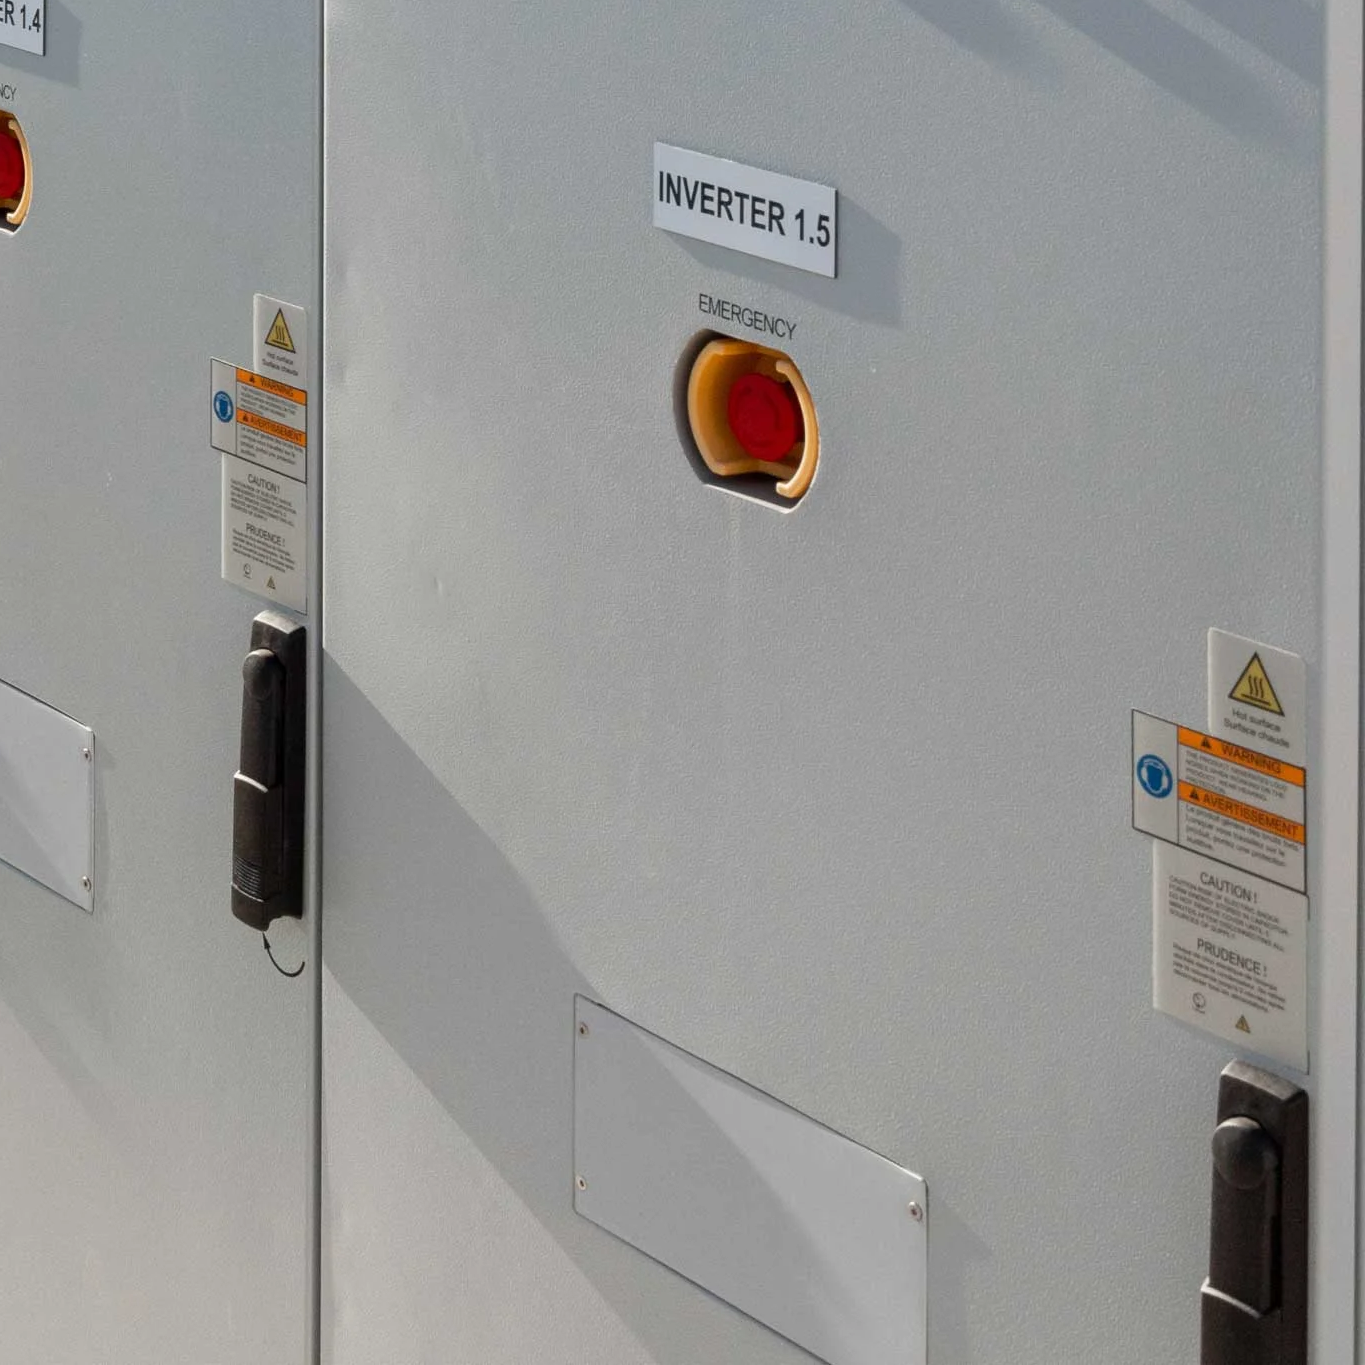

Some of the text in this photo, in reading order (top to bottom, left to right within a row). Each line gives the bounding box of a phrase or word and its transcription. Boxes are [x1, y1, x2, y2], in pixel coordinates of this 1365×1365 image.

[20, 3, 42, 34] 1.4
[659, 170, 831, 248] INVERTER 1.5
[699, 293, 797, 341] EMERGENCY
[245, 522, 282, 546] PRUDENCE
[1223, 717, 1290, 748] Surface chaude
[1232, 707, 1281, 732] Hot surface
[1221, 744, 1282, 774] WARNING
[1204, 793, 1299, 836] AVERTISSEMENT
[1200, 872, 1251, 902] CAUTION
[1197, 938, 1261, 975] PRUDENCE
